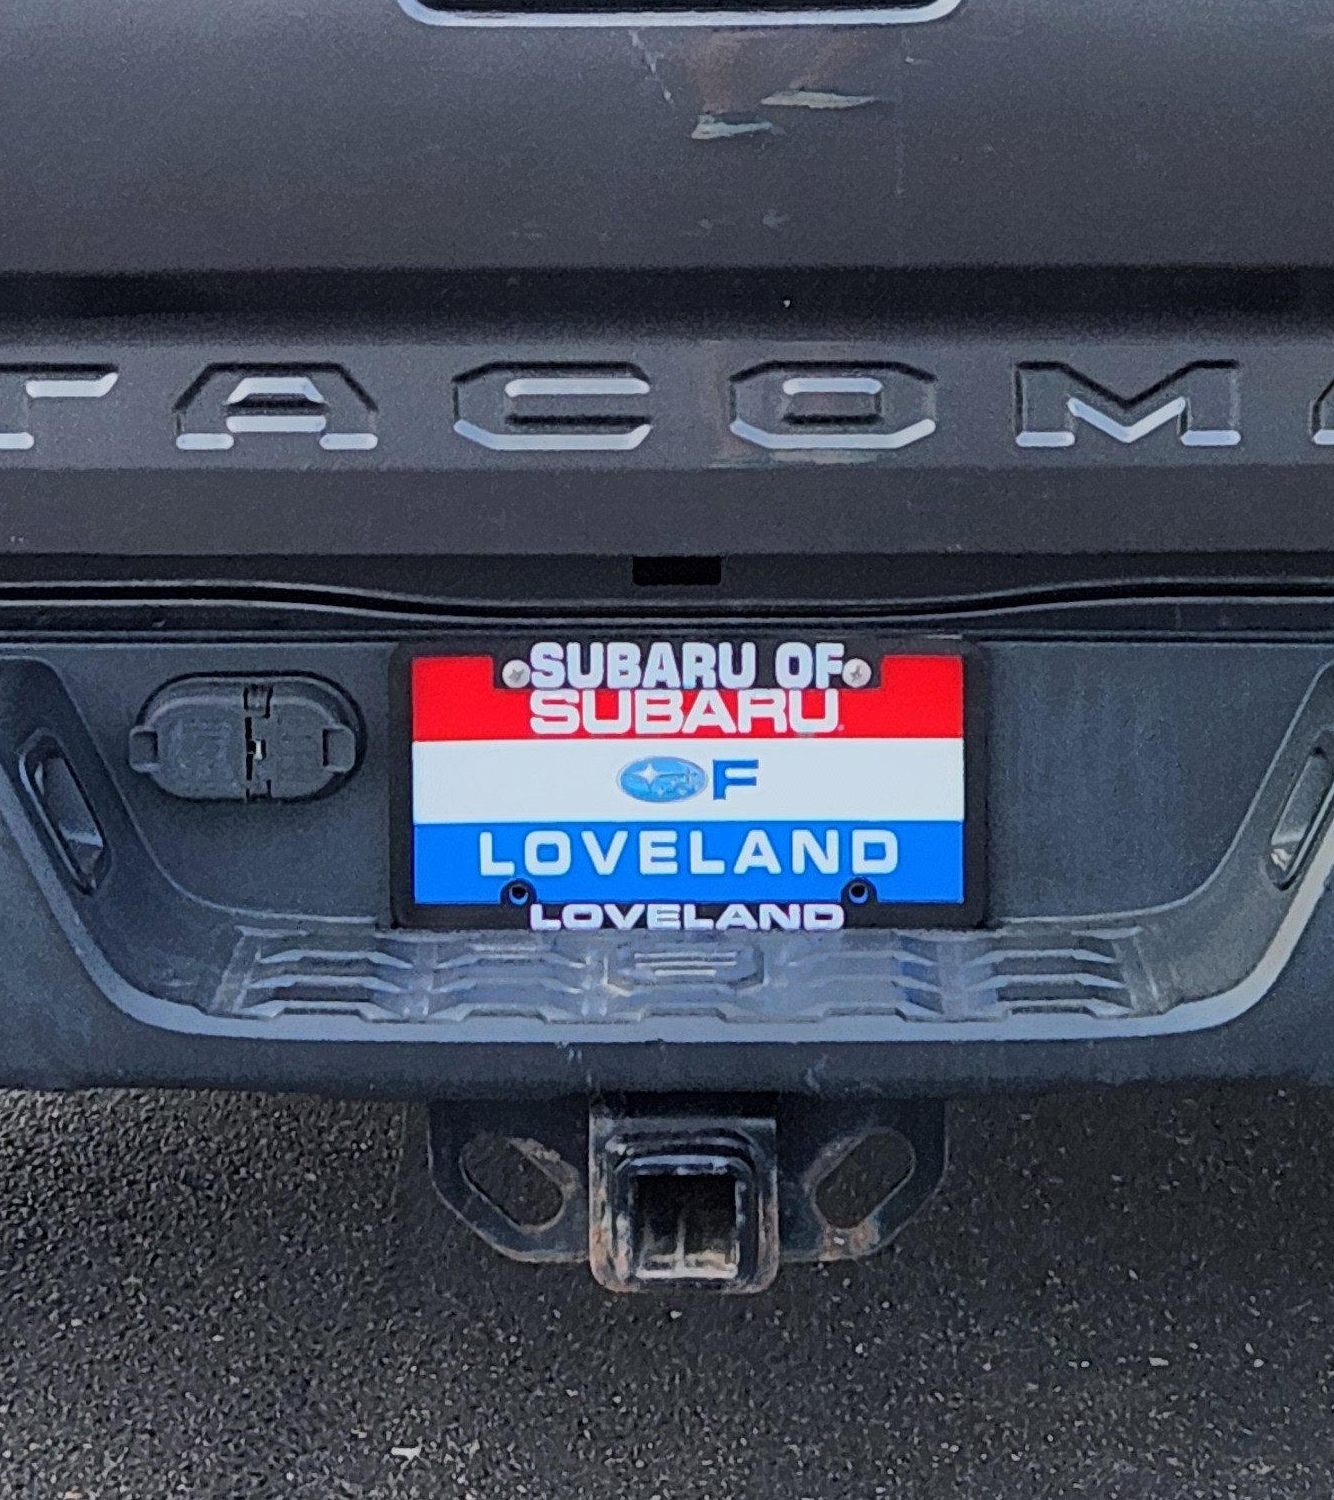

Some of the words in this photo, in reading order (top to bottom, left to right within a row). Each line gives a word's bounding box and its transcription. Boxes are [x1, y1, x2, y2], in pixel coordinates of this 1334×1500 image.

[530, 641, 754, 690] SUBARU
[775, 641, 846, 690] OF
[529, 689, 840, 735] SUBARU
[479, 829, 898, 876] LOVELAND
[529, 903, 845, 931] LOVELAND
